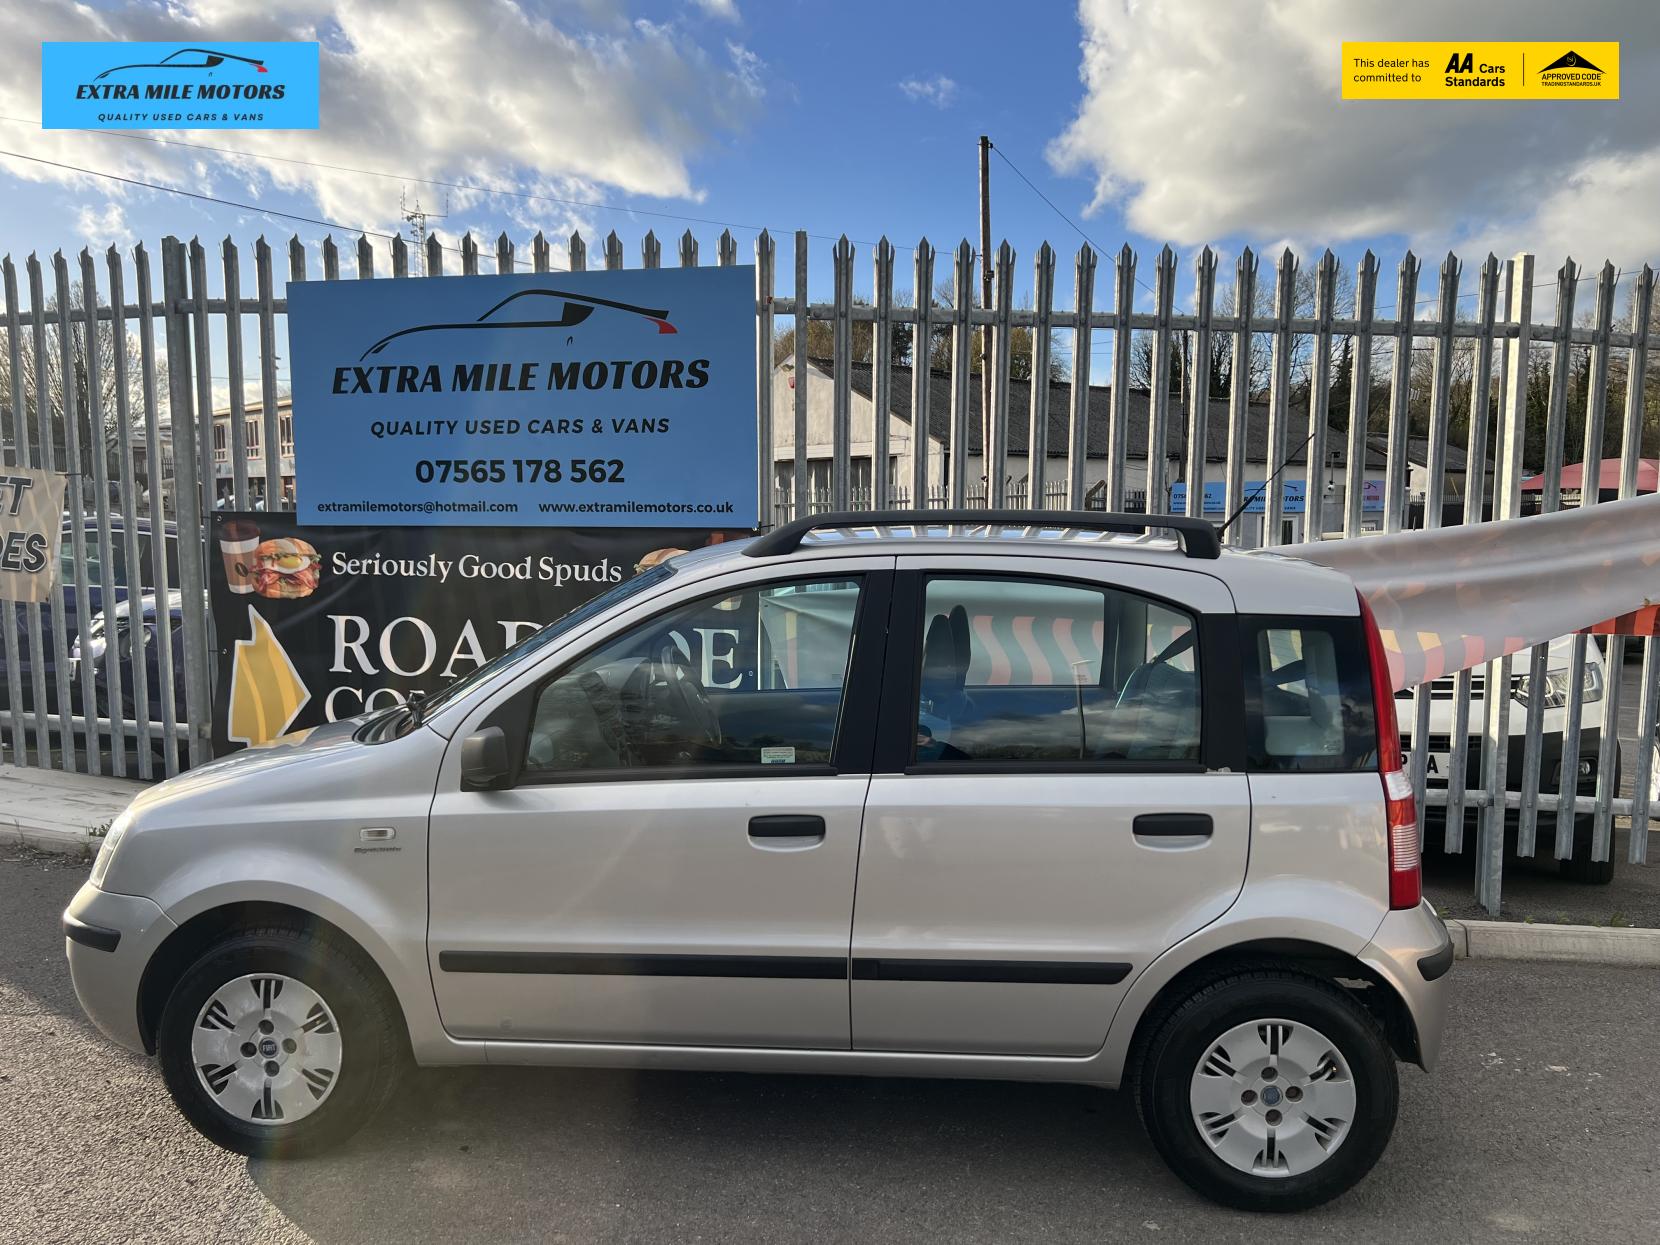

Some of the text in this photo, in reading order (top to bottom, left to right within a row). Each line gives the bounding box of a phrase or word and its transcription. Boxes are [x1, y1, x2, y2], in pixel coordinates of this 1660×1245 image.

[332, 359, 711, 394] EXTRA MILE MOTORS
[370, 417, 670, 437] QUALITY USED CARS & VANS
[415, 459, 625, 484] 07565 178 562
[317, 500, 734, 514] extramilemotors@hotmail.com www.extramilemotors.co.uk
[332, 551, 623, 587] Seriously Good Spuds
